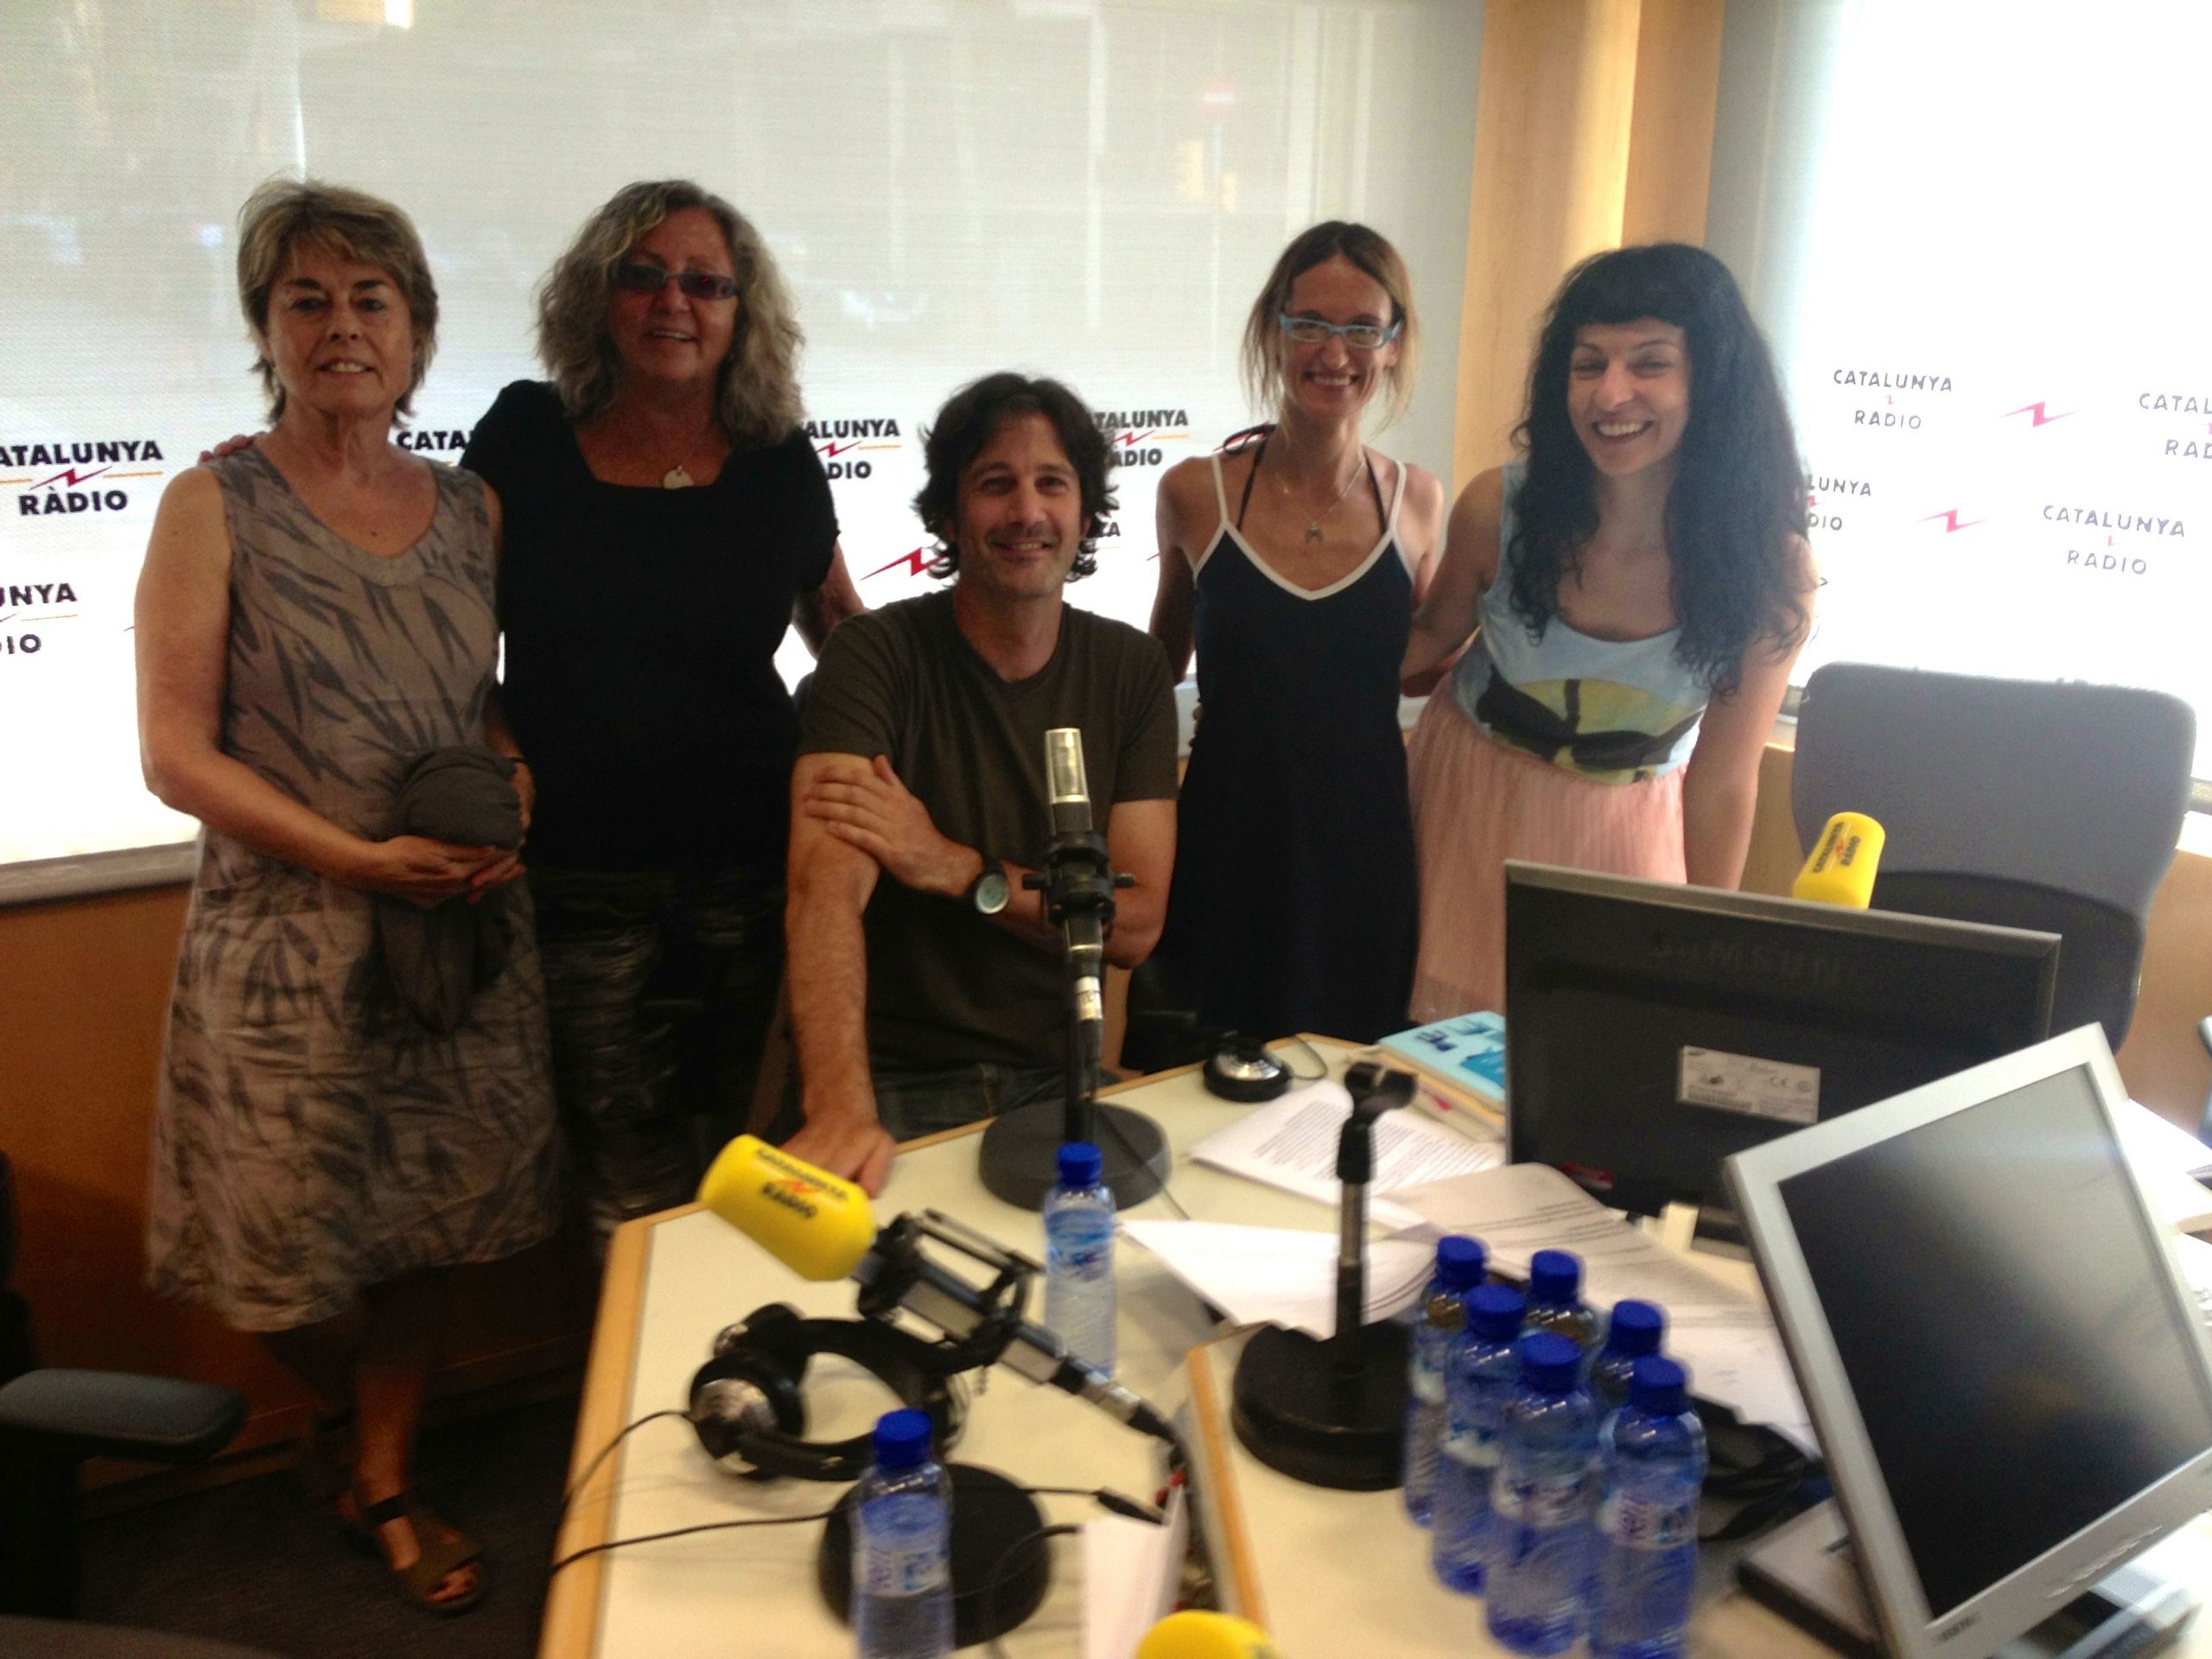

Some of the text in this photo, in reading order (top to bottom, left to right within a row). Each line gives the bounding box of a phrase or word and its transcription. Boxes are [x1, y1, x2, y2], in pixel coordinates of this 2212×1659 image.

[1834, 369, 1952, 392] CATALUNYA
[1854, 410, 1922, 429] RADIO
[397, 430, 472, 450] CATA
[19, 486, 128, 516] RÀDIO
[2043, 505, 2185, 537] CATALUNYA
[2067, 550, 2147, 575] RADIO
